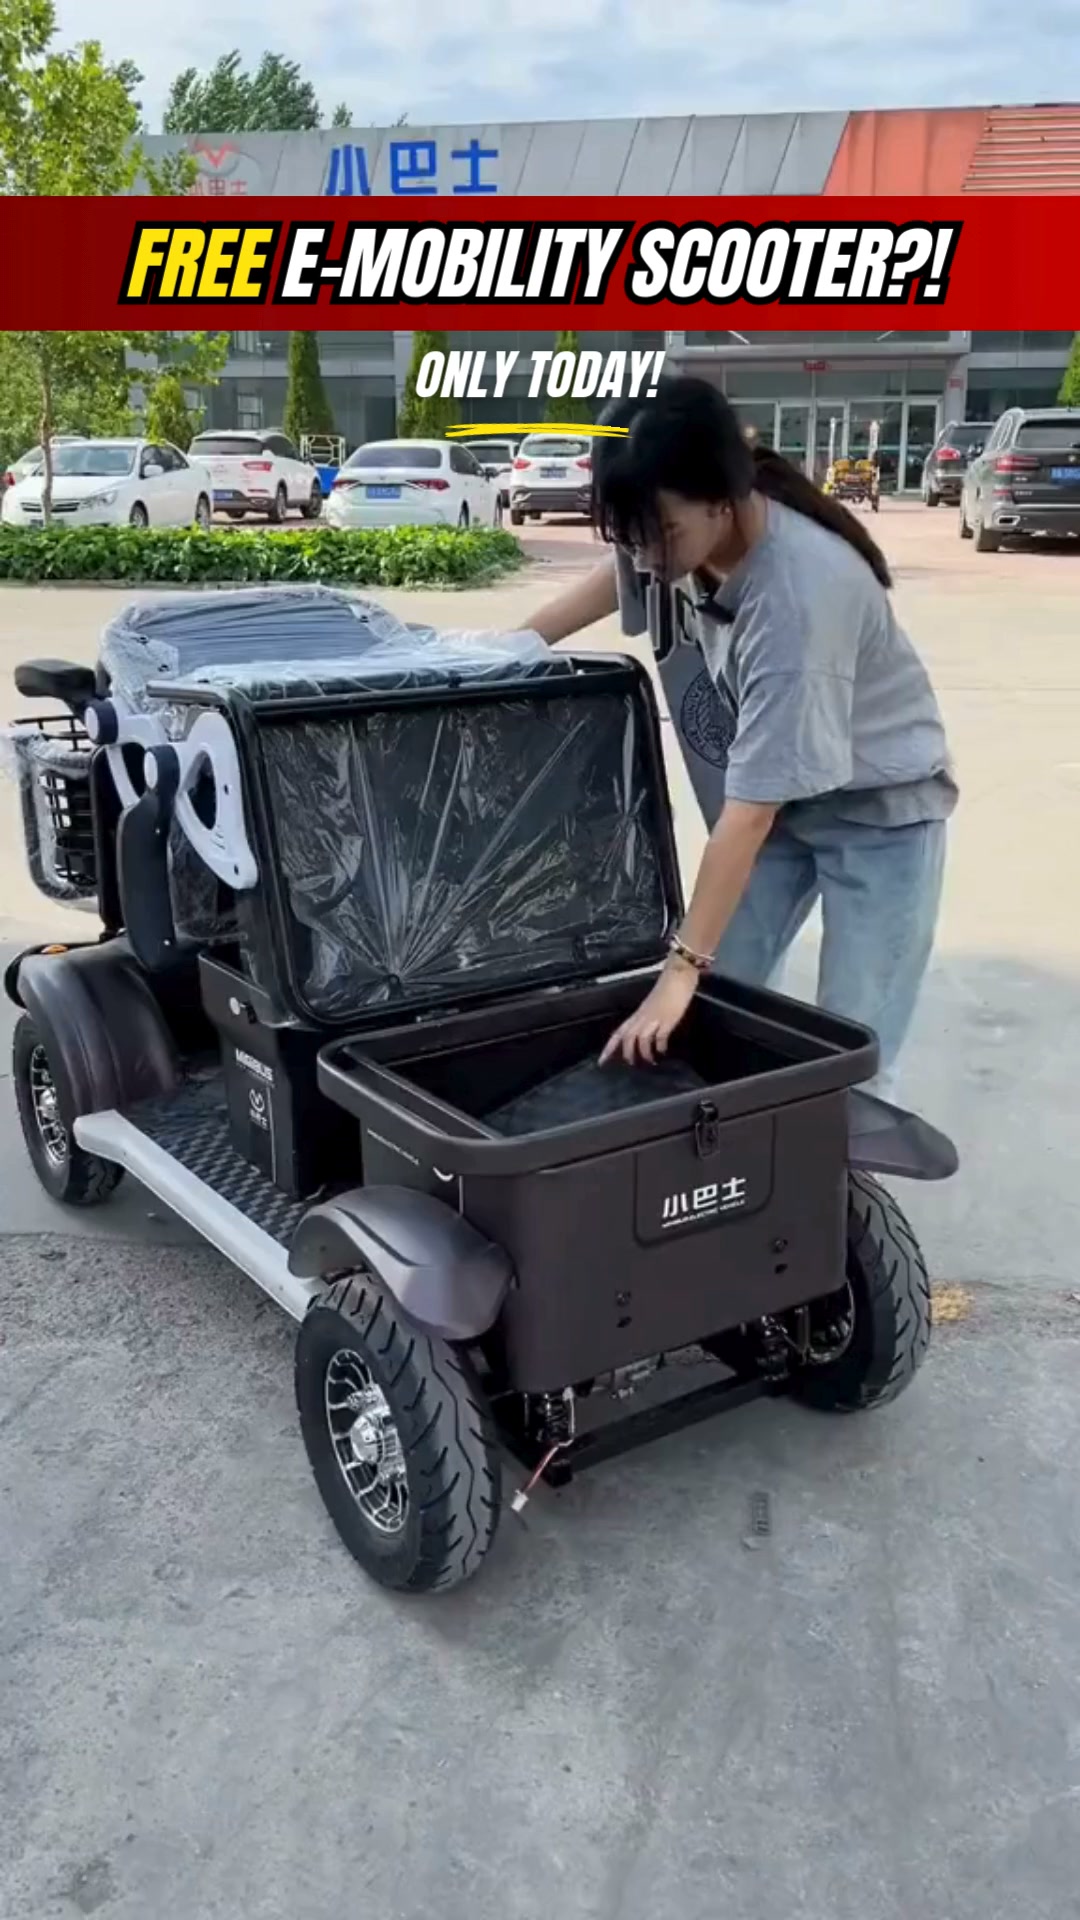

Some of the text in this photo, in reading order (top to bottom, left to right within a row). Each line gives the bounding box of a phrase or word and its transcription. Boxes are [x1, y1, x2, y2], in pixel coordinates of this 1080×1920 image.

[325, 139, 499, 196] 小巴士
[662, 1176, 747, 1219] 小巴士
